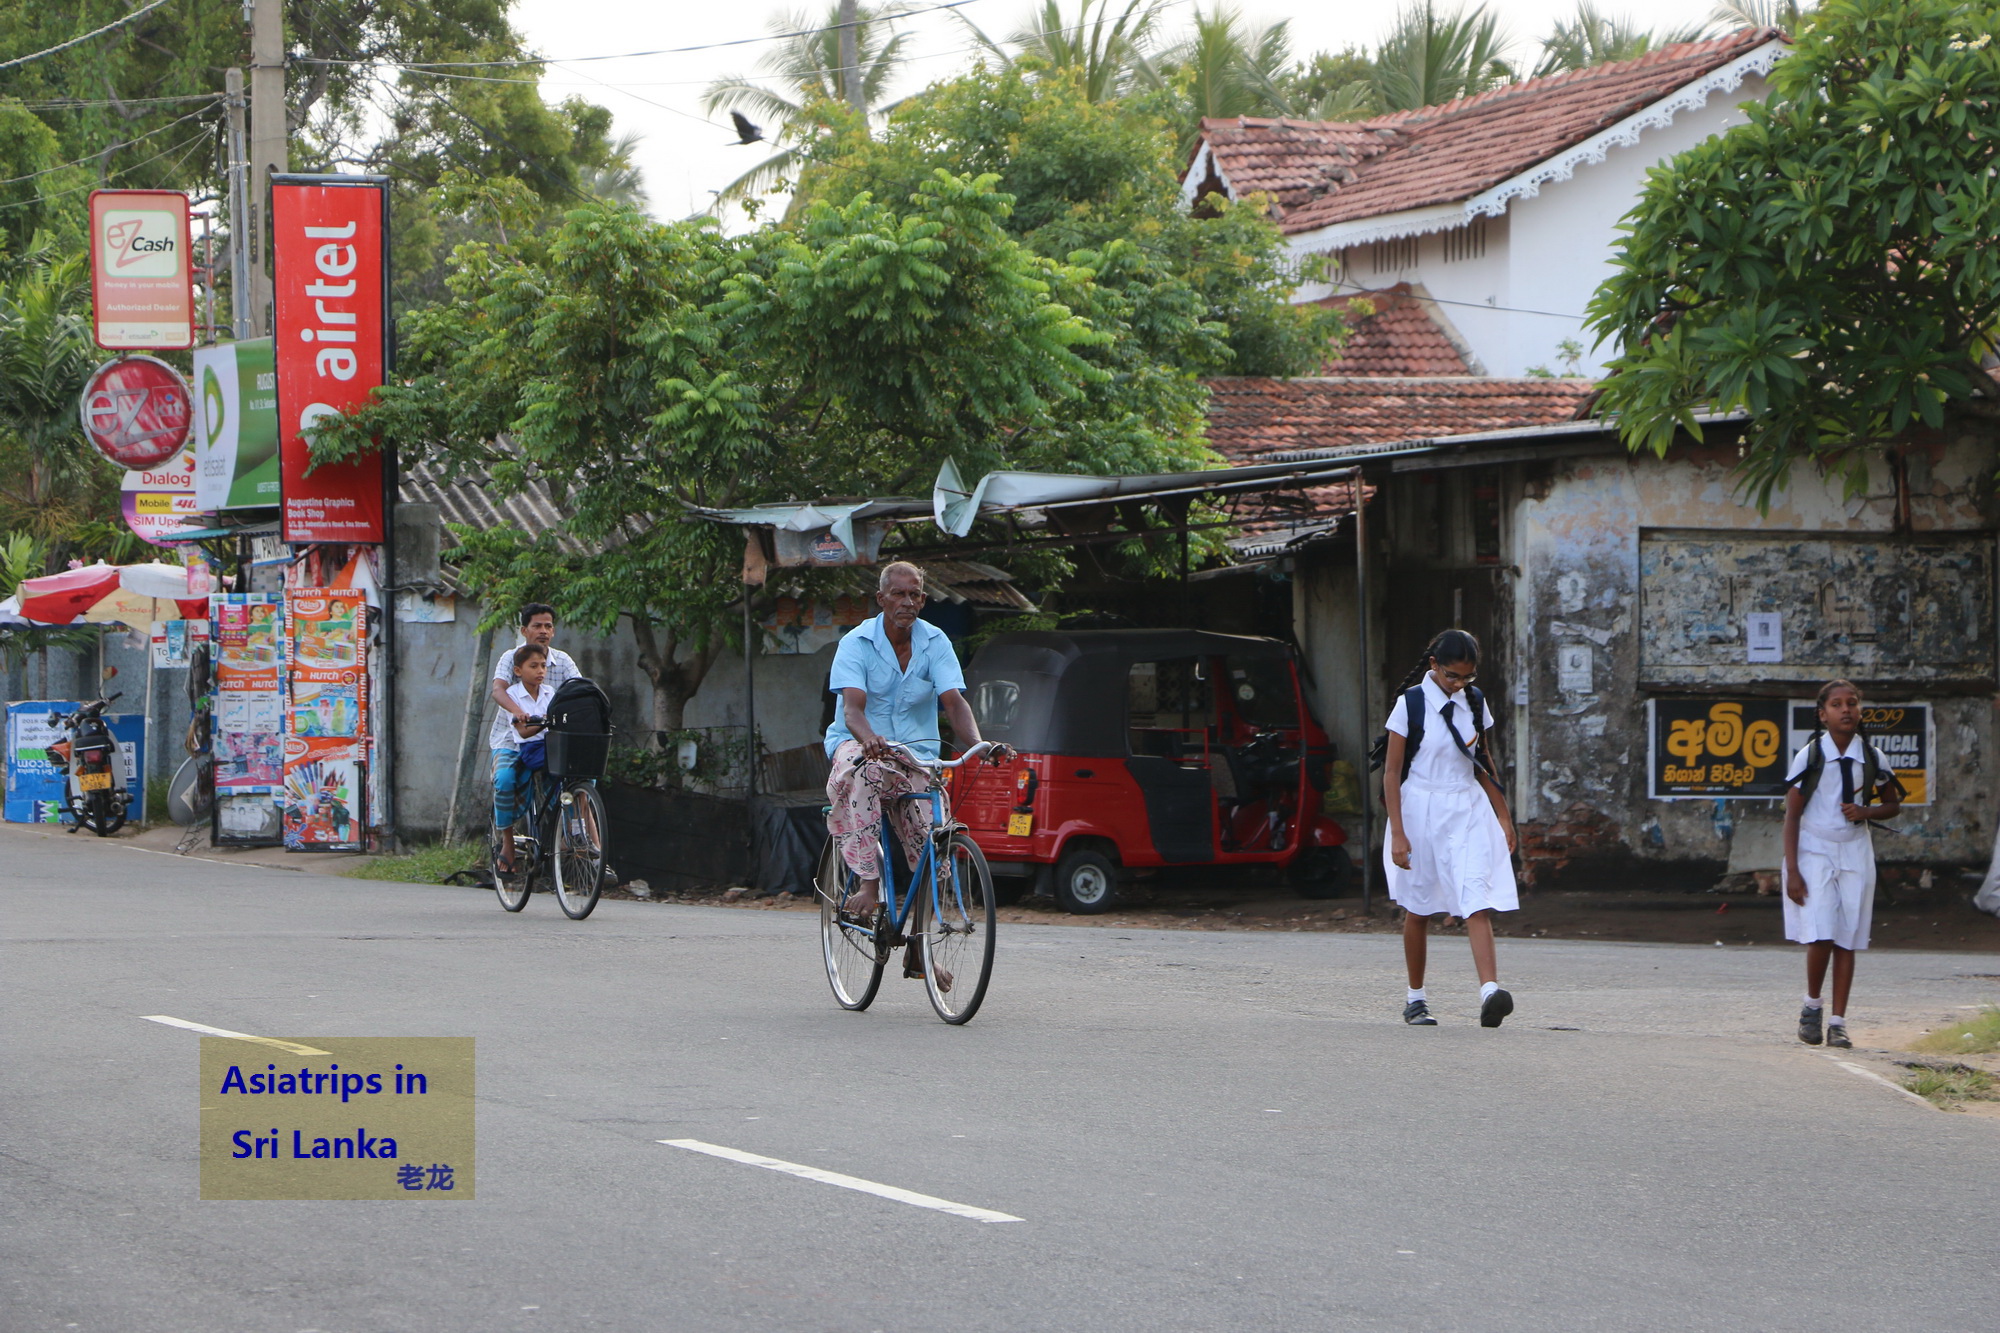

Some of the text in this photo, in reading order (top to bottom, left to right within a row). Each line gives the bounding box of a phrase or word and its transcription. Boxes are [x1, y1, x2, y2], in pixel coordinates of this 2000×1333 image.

[132, 236, 174, 252] Cash
[300, 220, 358, 381] airtel
[154, 393, 183, 417] kit
[142, 472, 191, 487] Dialog
[139, 499, 170, 508] Mobile
[287, 498, 354, 508] Augustine Graphics
[134, 516, 155, 526] SIM
[287, 508, 325, 520] Book Shop
[1862, 708, 1904, 728] 2019
[1667, 702, 1780, 768] අමිල
